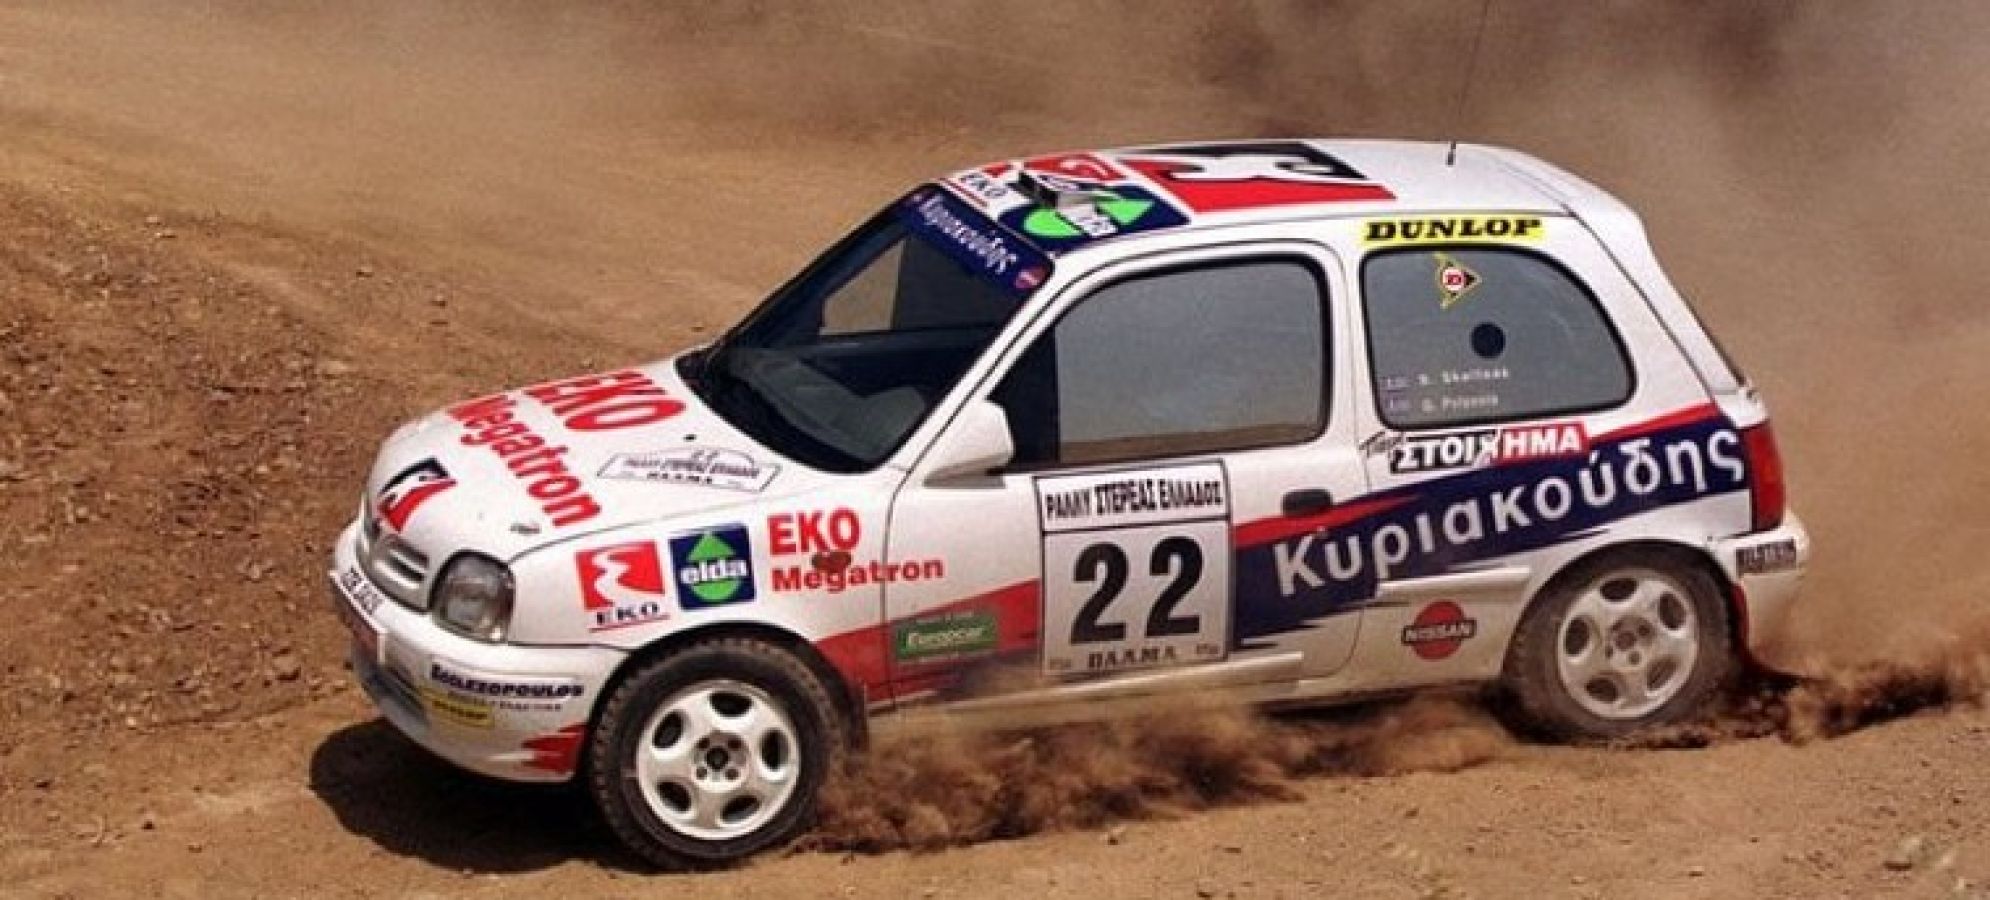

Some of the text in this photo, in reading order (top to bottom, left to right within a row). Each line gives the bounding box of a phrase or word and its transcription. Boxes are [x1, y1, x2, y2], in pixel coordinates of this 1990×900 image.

[1365, 218, 1543, 241] DUNLOP
[1272, 428, 1747, 597] Κυριακούδης
[766, 507, 861, 556] EKO
[680, 556, 748, 587] elda
[772, 557, 945, 594] Megatron
[1070, 536, 1204, 645] 22
[595, 600, 659, 627] EKO
[1405, 621, 1471, 643] NISSAN
